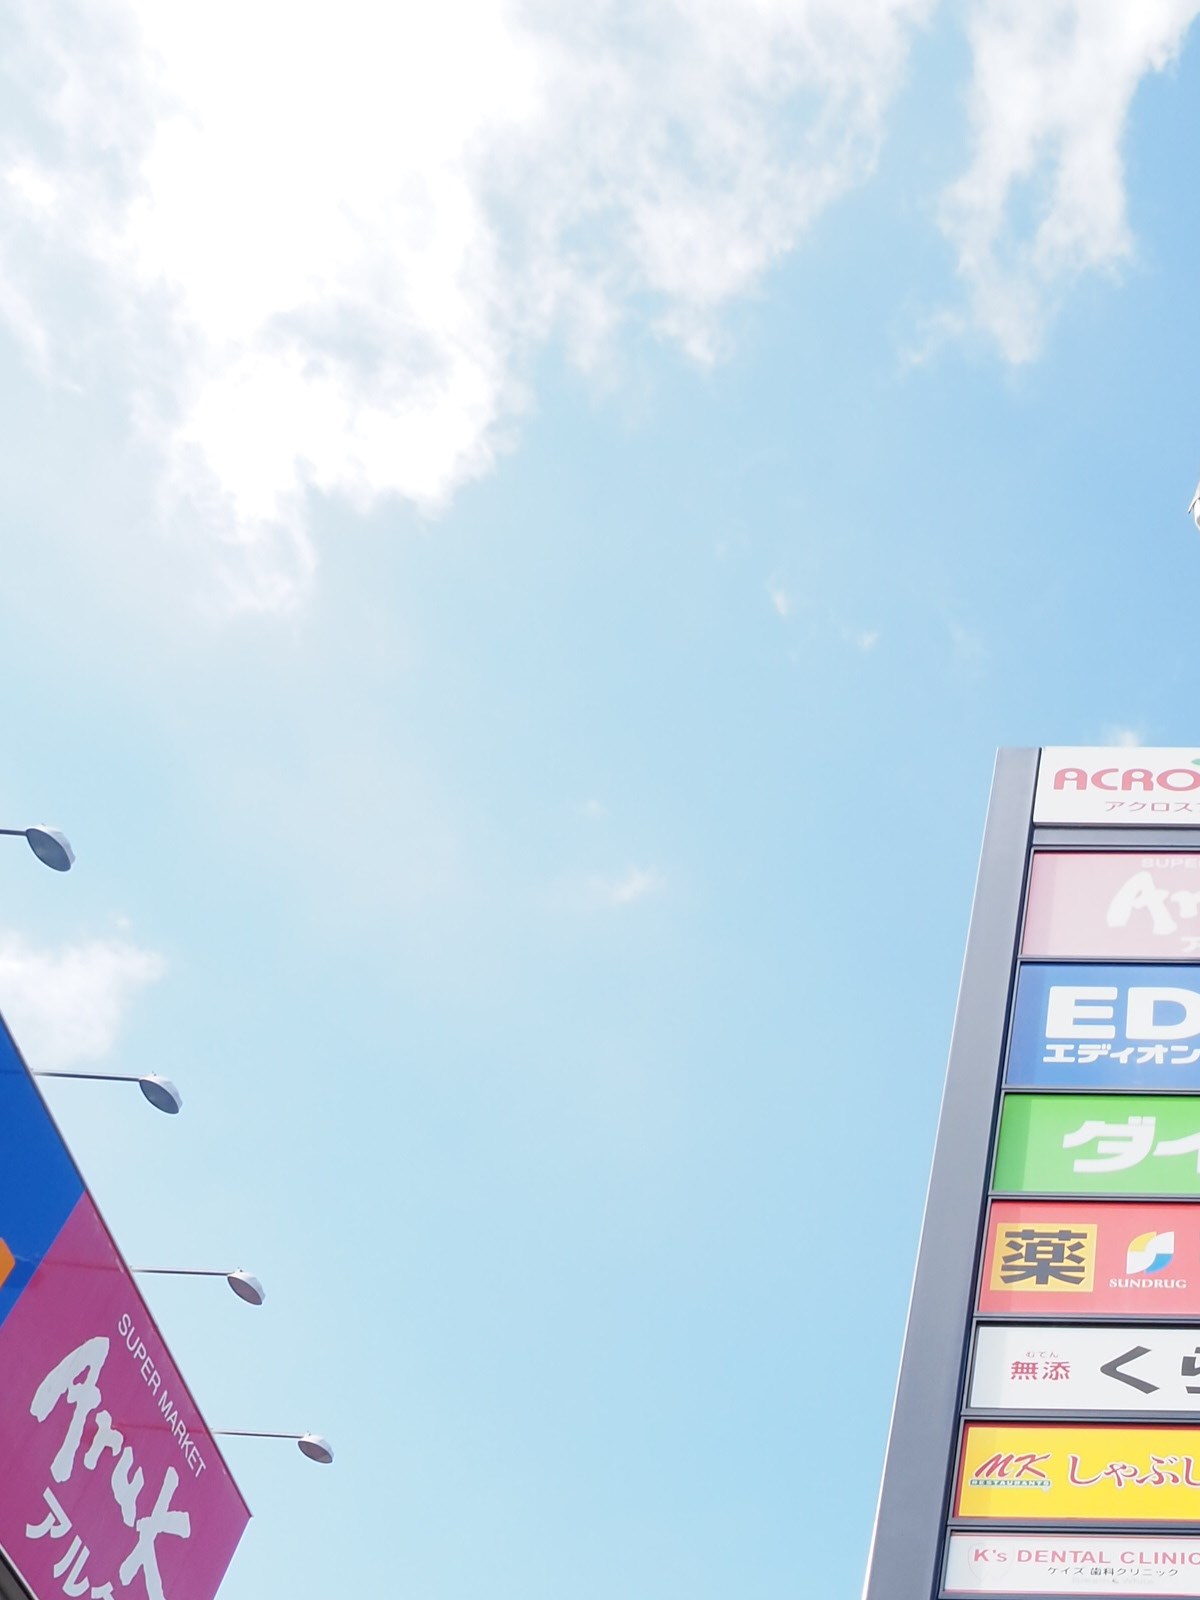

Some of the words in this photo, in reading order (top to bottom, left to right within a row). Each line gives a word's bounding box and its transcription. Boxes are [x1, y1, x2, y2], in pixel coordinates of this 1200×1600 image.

[1043, 1043, 1200, 1065] エディオン
[1000, 1229, 1087, 1285] 薬
[1109, 1278, 1187, 1289] SUNDRUG
[1010, 1360, 1071, 1381] 無添
[117, 1312, 160, 1399] SUPER
[158, 1396, 206, 1481] MARKET
[974, 1548, 1008, 1563] K's
[1016, 1550, 1112, 1565] DENTAL
